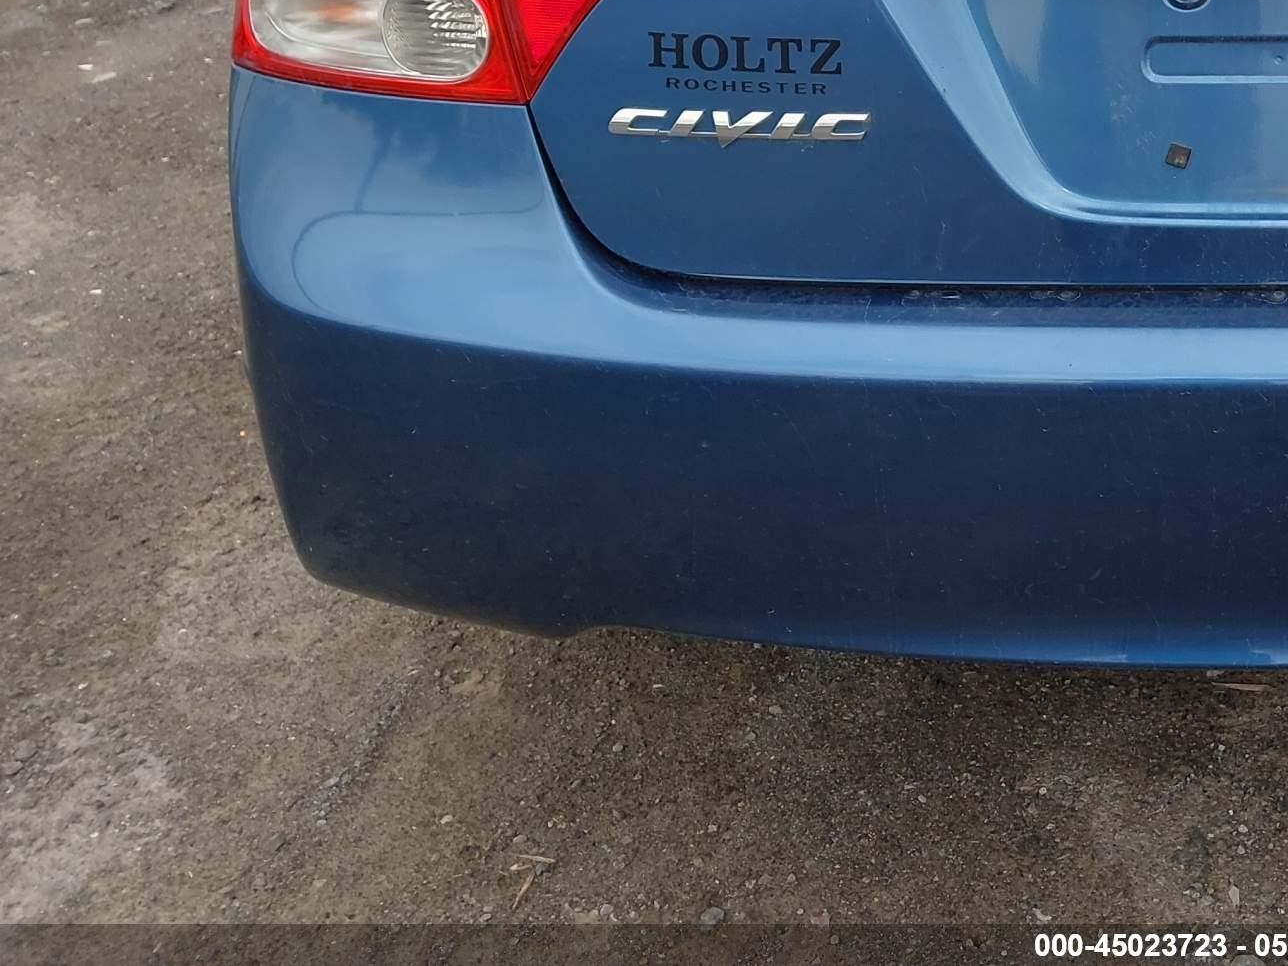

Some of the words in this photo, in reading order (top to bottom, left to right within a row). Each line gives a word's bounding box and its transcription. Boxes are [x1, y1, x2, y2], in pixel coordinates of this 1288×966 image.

[648, 31, 842, 75] HOLTZ
[665, 77, 827, 95] ROCHESTER
[607, 107, 870, 148] CIVIC
